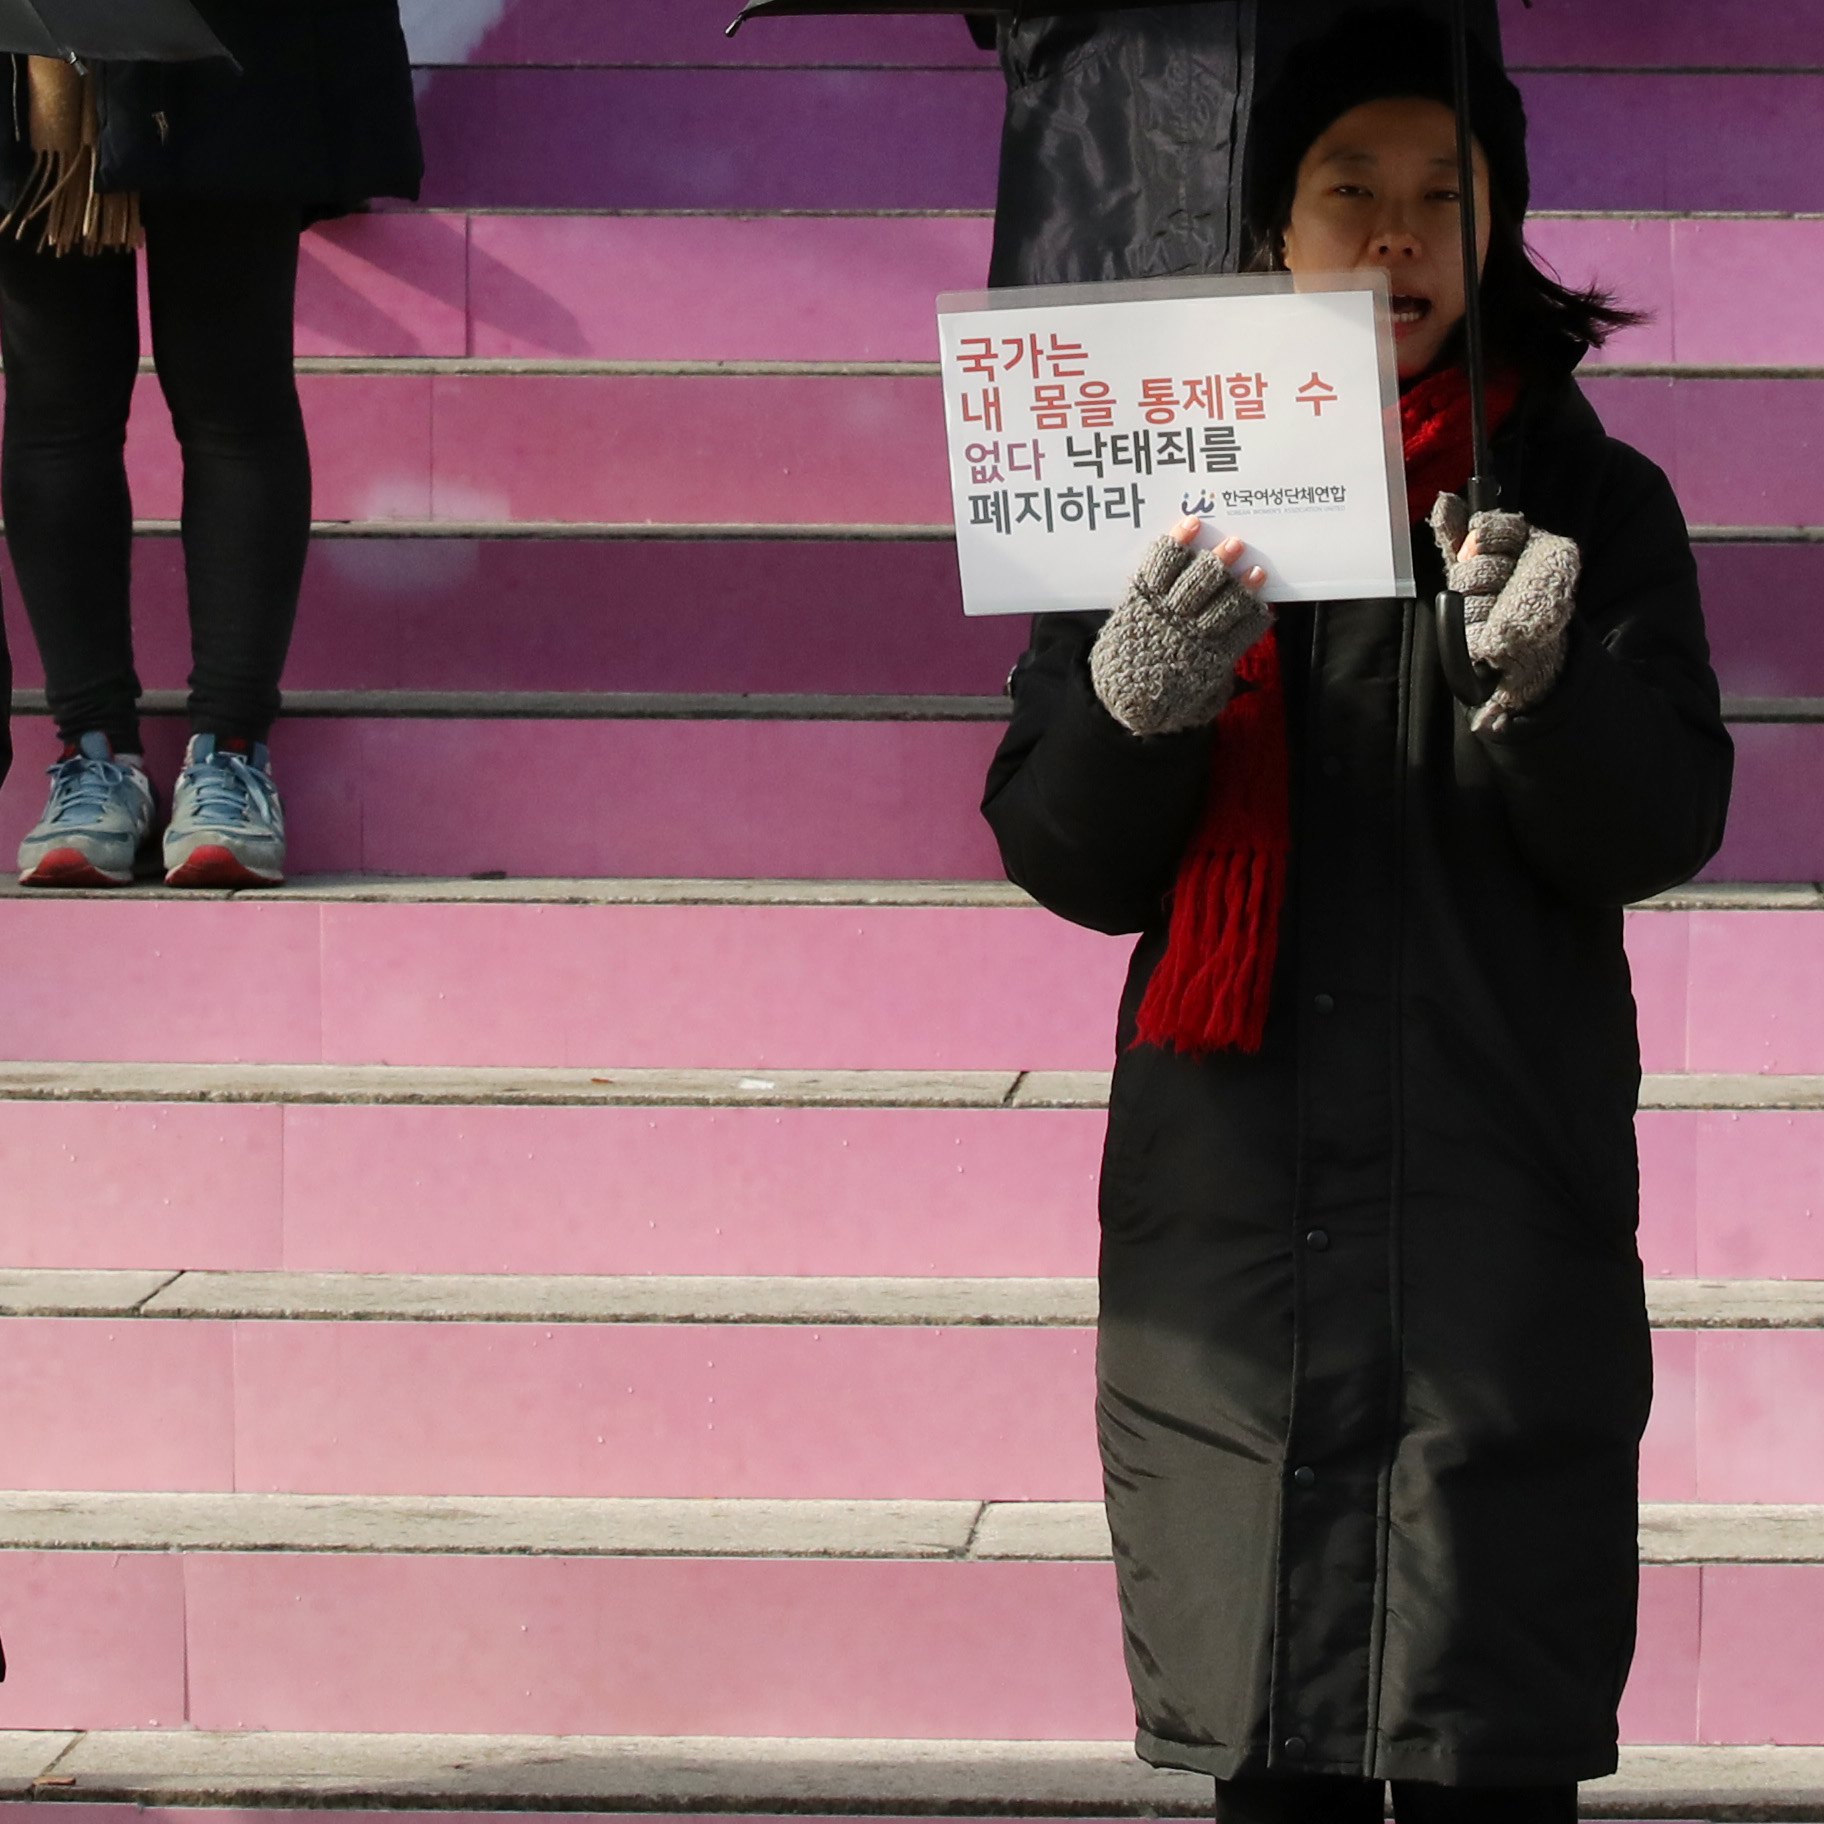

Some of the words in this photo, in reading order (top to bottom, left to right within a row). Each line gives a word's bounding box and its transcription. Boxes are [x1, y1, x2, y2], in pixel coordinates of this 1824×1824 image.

[956, 334, 1089, 382] 국가는
[961, 387, 1003, 432] 내
[1029, 381, 1117, 430] 몸을
[1138, 372, 1268, 424] 통제할
[1295, 372, 1338, 417] 수
[965, 439, 1045, 484] 없다
[1067, 426, 1242, 477] 낙태죄를
[968, 483, 1145, 535] 폐지하라
[1222, 486, 1346, 507] 한국여성단체연합
